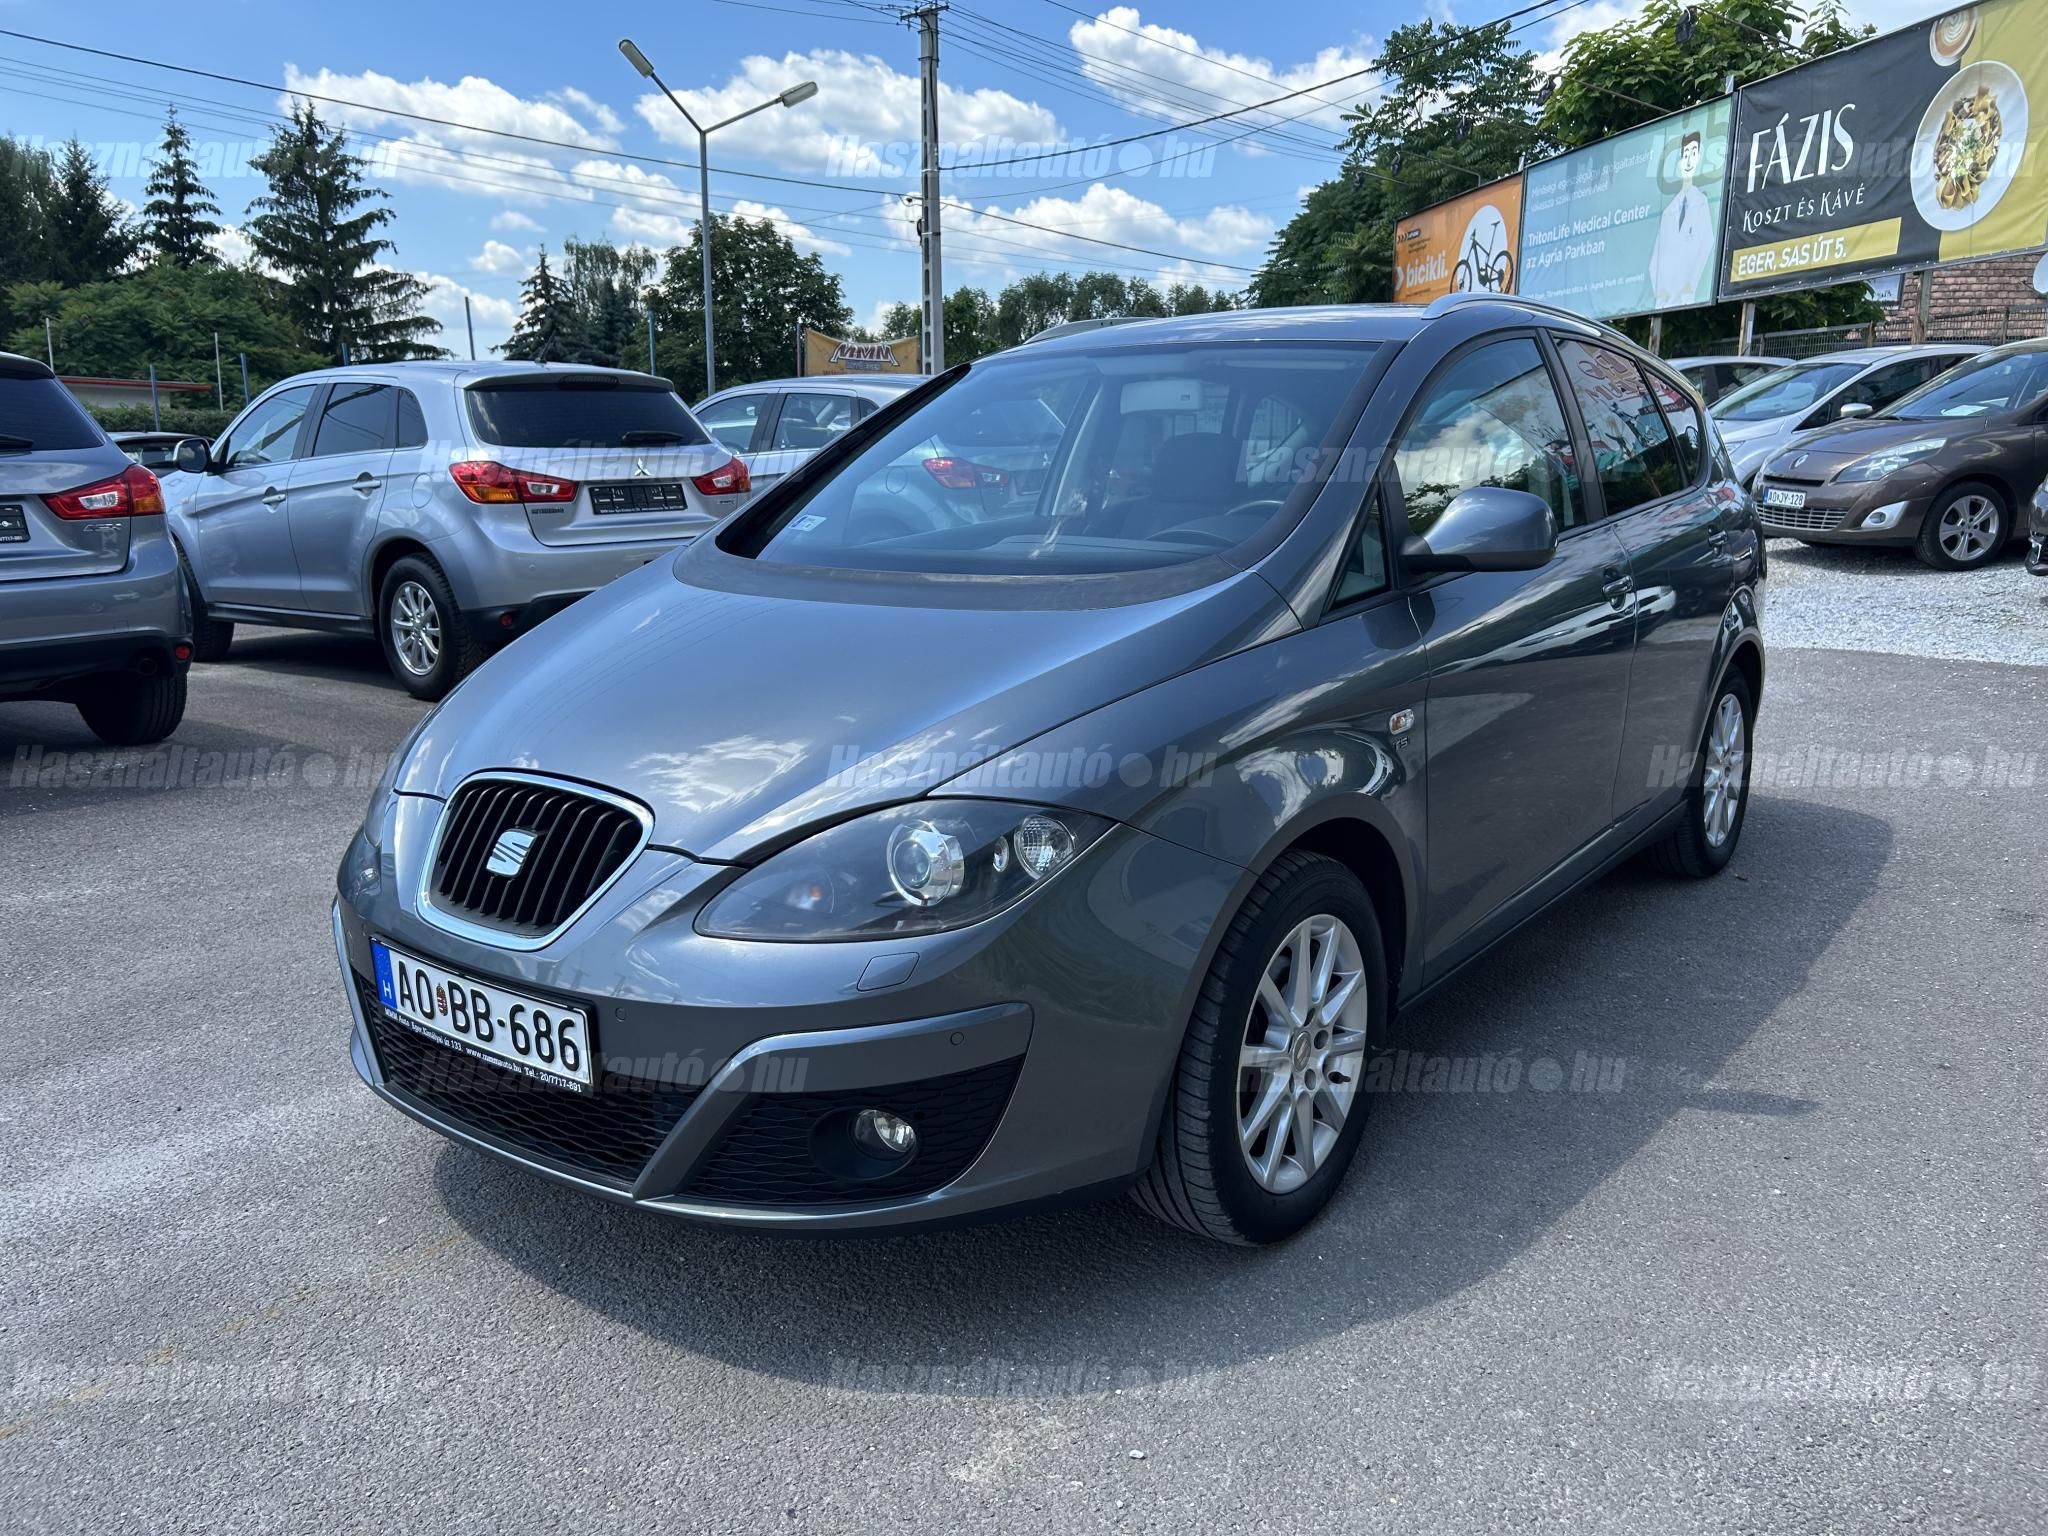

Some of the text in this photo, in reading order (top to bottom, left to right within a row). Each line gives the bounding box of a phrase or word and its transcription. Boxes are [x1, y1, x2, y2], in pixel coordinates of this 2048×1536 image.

[1747, 103, 1856, 193] FÁZIS
[1528, 204, 1651, 247] TritonLife Medical Center
[1526, 239, 1605, 269] az Agria Parkban
[1738, 236, 1847, 275] EGER, SAS ÚT 5.
